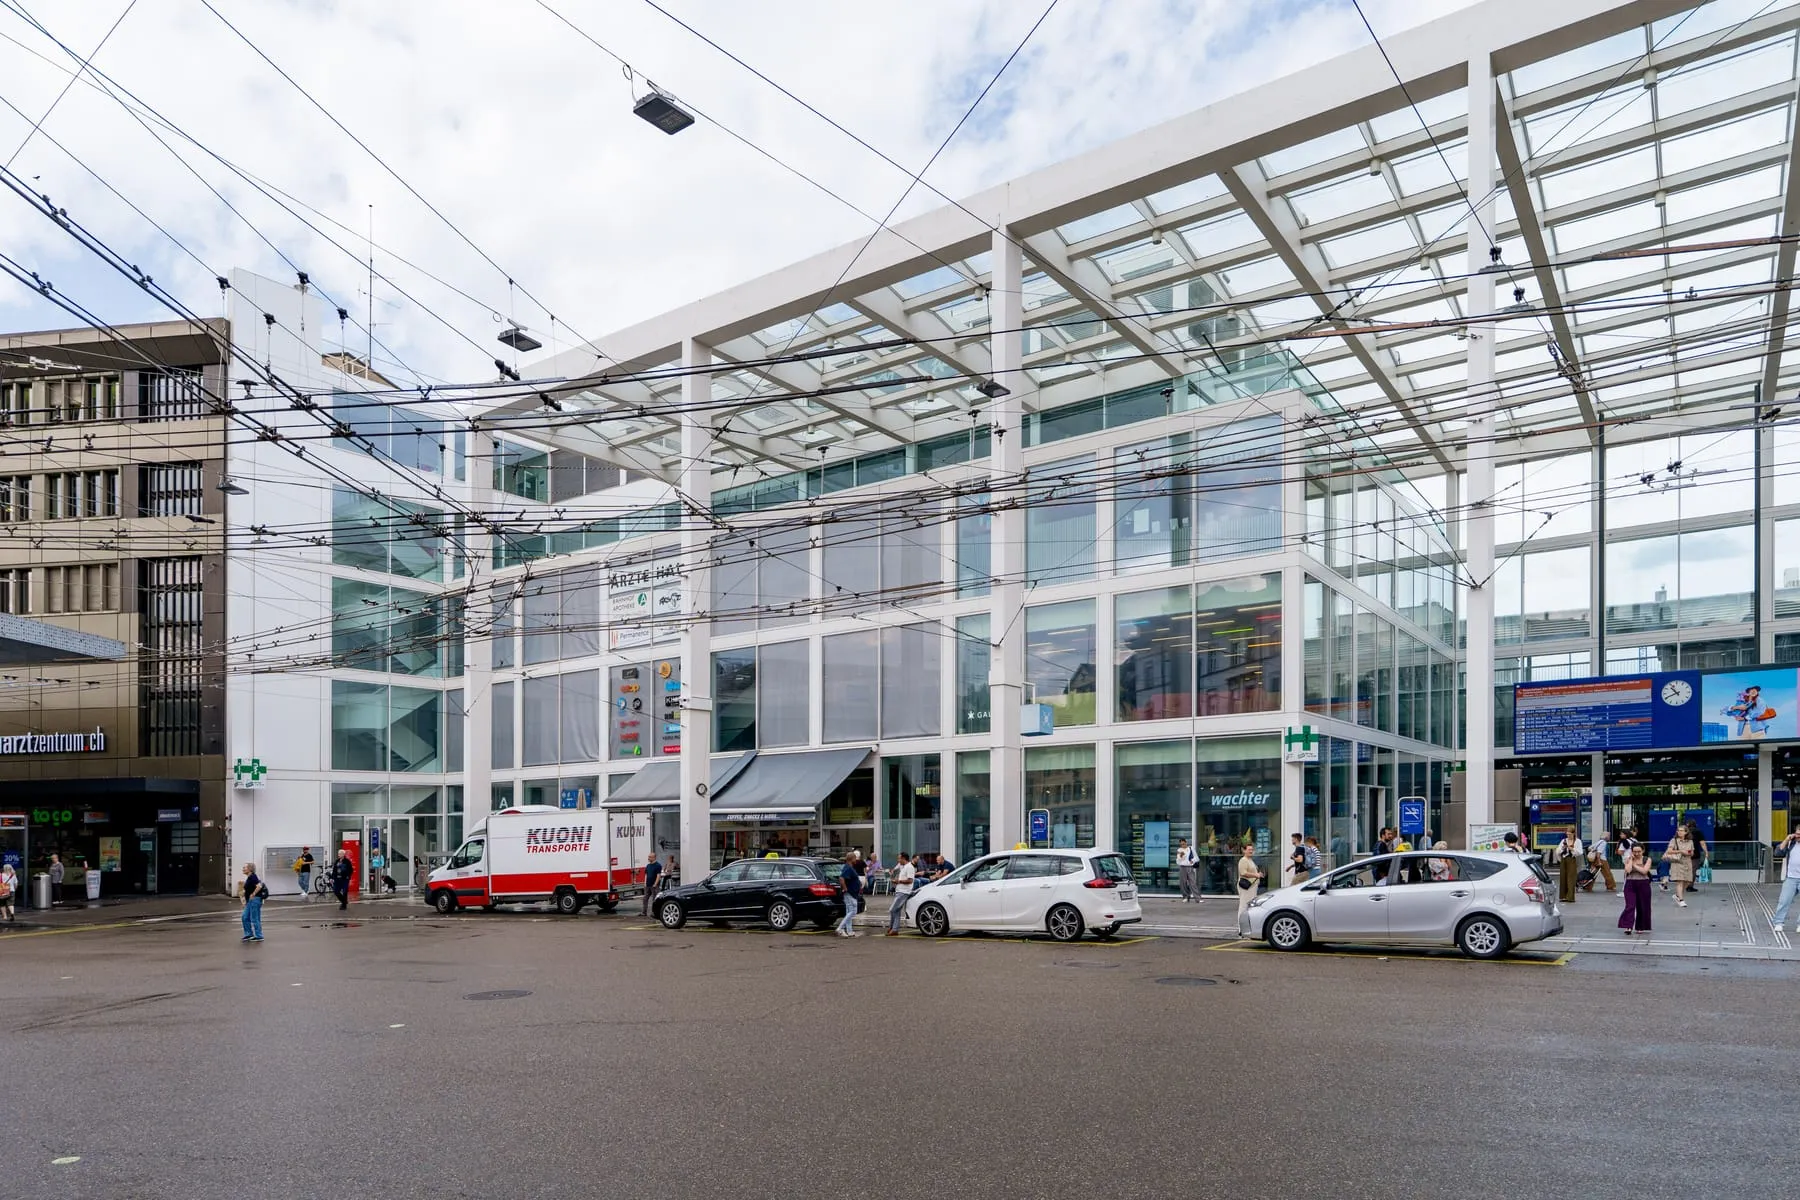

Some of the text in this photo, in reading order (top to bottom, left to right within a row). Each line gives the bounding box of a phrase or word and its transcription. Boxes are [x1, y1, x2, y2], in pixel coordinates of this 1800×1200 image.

[609, 568, 650, 590] ÄRZTE
[0, 725, 105, 754] arztzentrum.ch
[1211, 789, 1270, 806] wachter
[33, 809, 50, 823] to
[52, 810, 73, 826] go
[526, 825, 593, 845] KUONI
[616, 826, 646, 838] KUONI
[526, 843, 590, 853] TRANSPORTE
